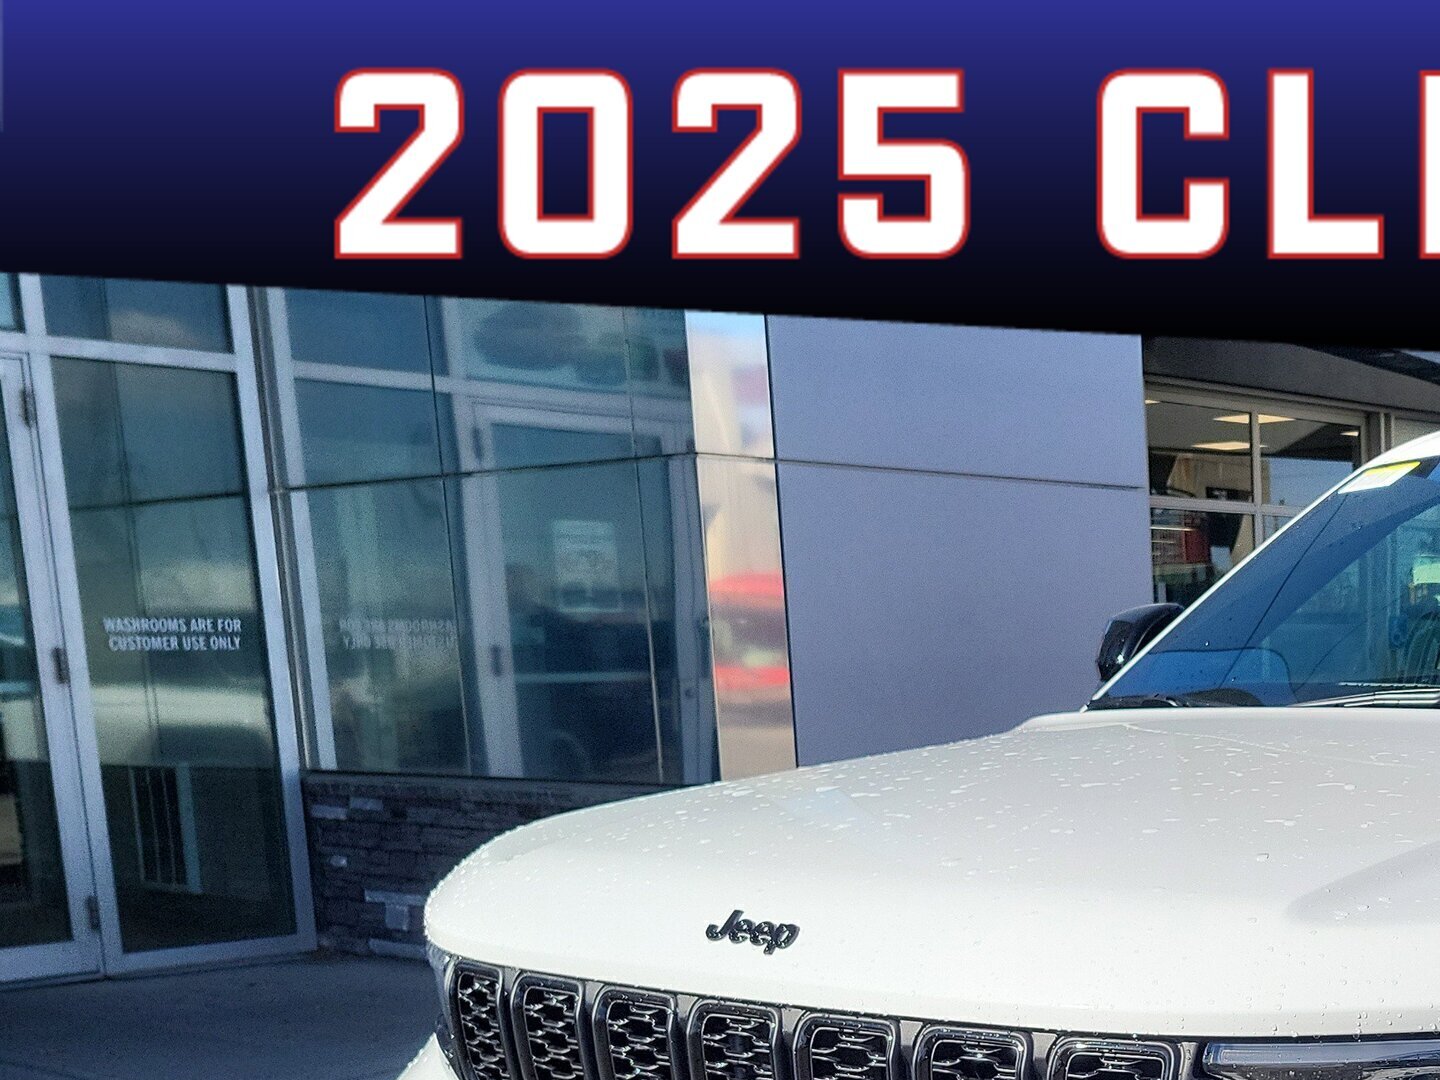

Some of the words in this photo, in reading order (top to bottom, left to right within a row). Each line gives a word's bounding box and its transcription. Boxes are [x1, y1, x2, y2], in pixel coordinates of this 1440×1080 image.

[103, 617, 187, 632] WASHROOMS
[190, 618, 214, 632] ARE
[217, 618, 241, 632] FOR
[108, 635, 179, 651] CUSTOMER
[182, 636, 207, 650] USE
[209, 635, 241, 650] ONLY
[705, 909, 801, 955] Jeep
